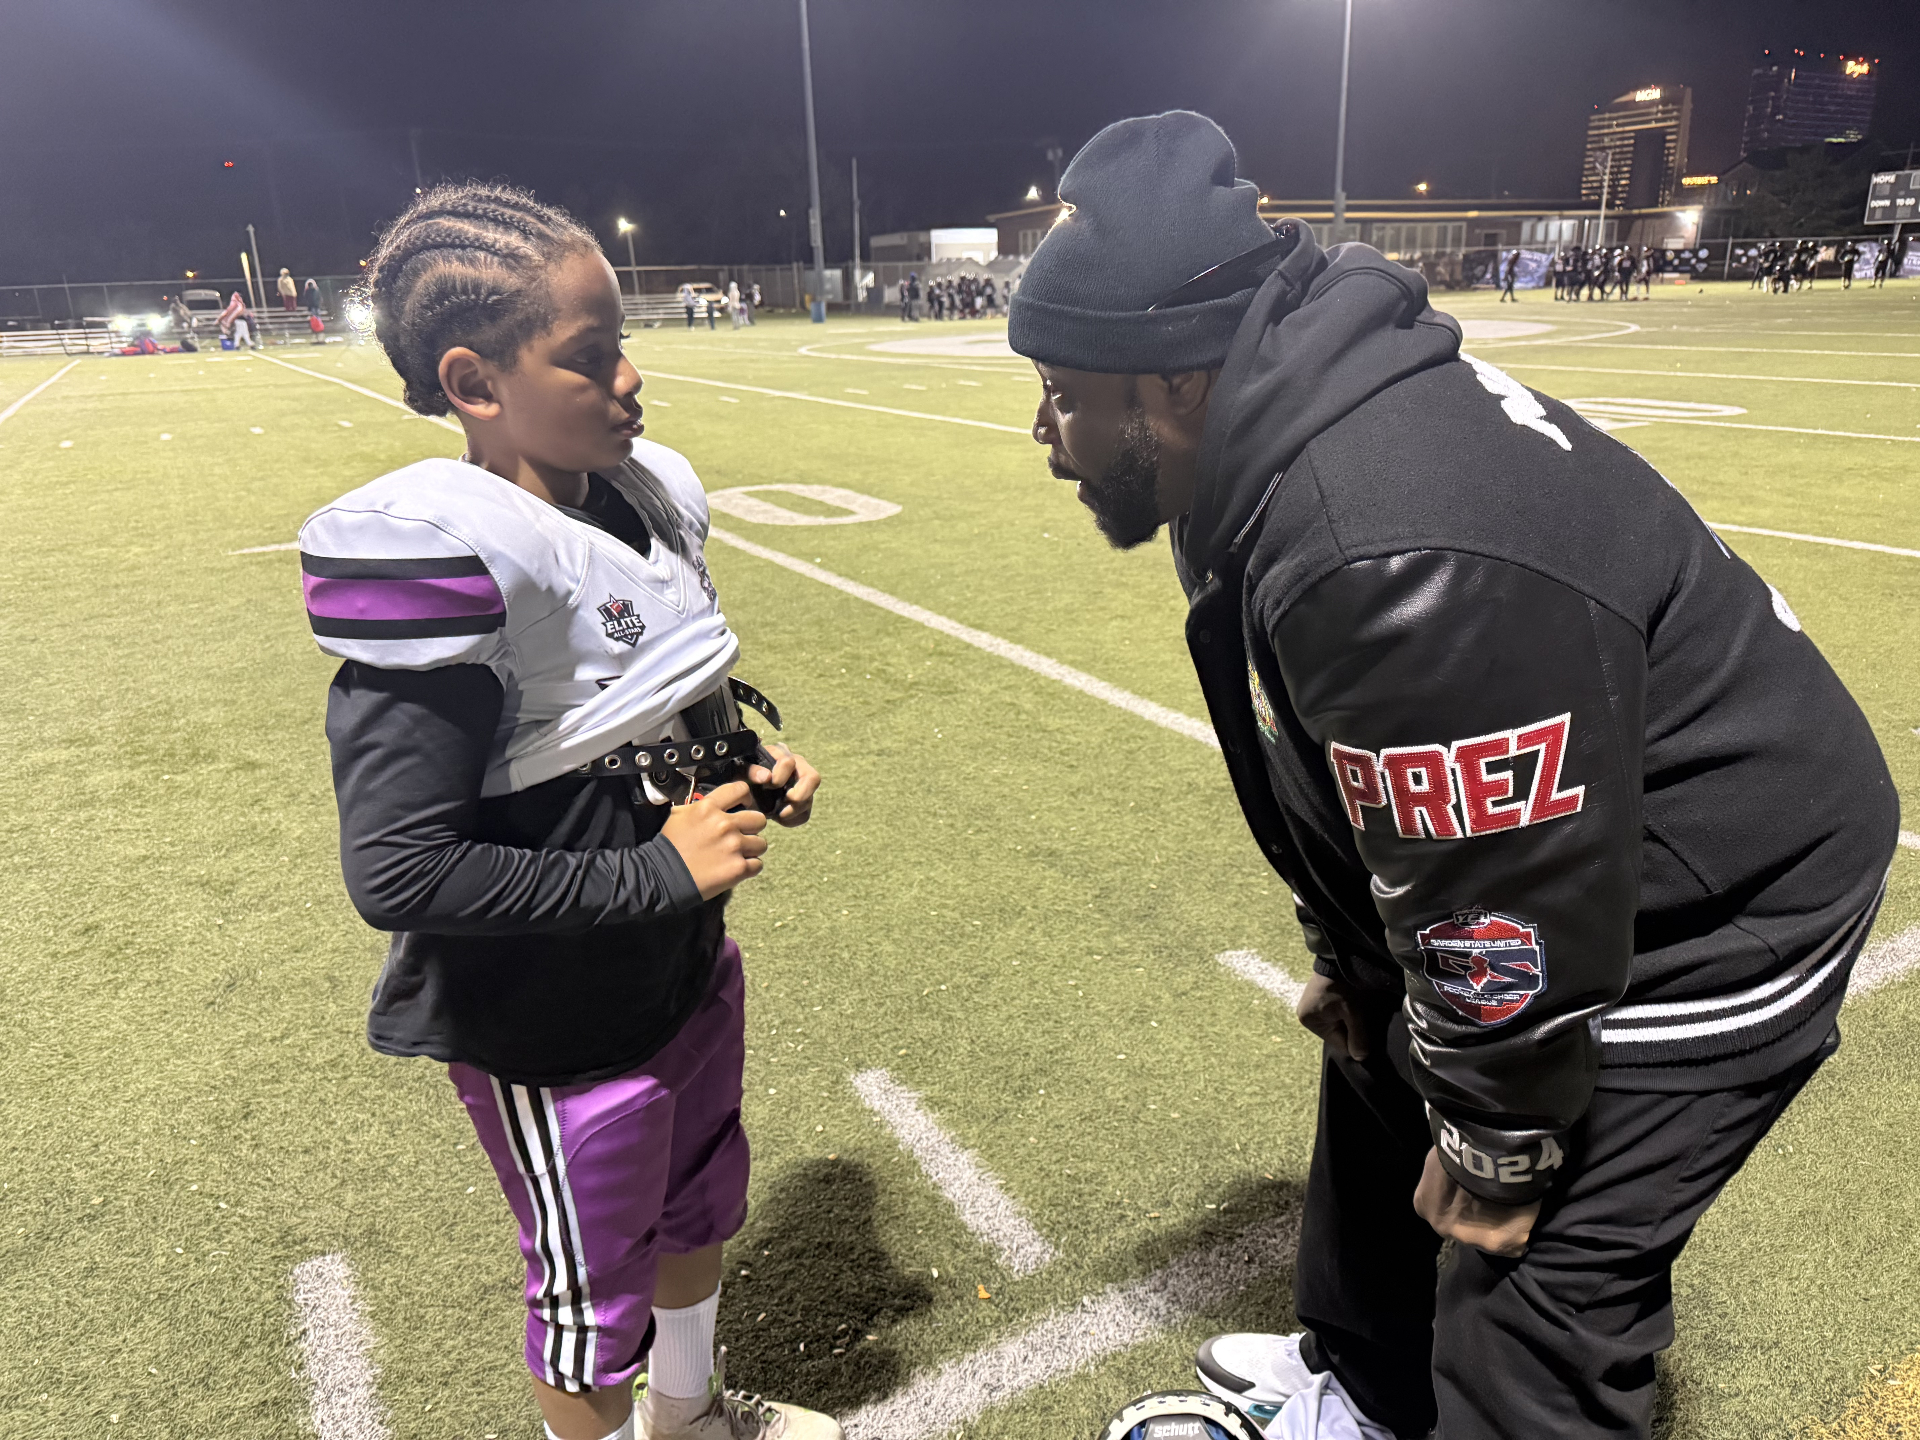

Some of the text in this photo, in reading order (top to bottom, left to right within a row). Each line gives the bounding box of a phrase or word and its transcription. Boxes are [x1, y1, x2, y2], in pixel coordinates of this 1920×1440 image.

[605, 615, 643, 634] ELITE
[1330, 711, 1586, 840] PREZ
[1430, 939, 1464, 947] GARDEN
[1490, 939, 1521, 947] UNITED
[1440, 1120, 1564, 1183] 2024
[1153, 1421, 1201, 1438] schutt
